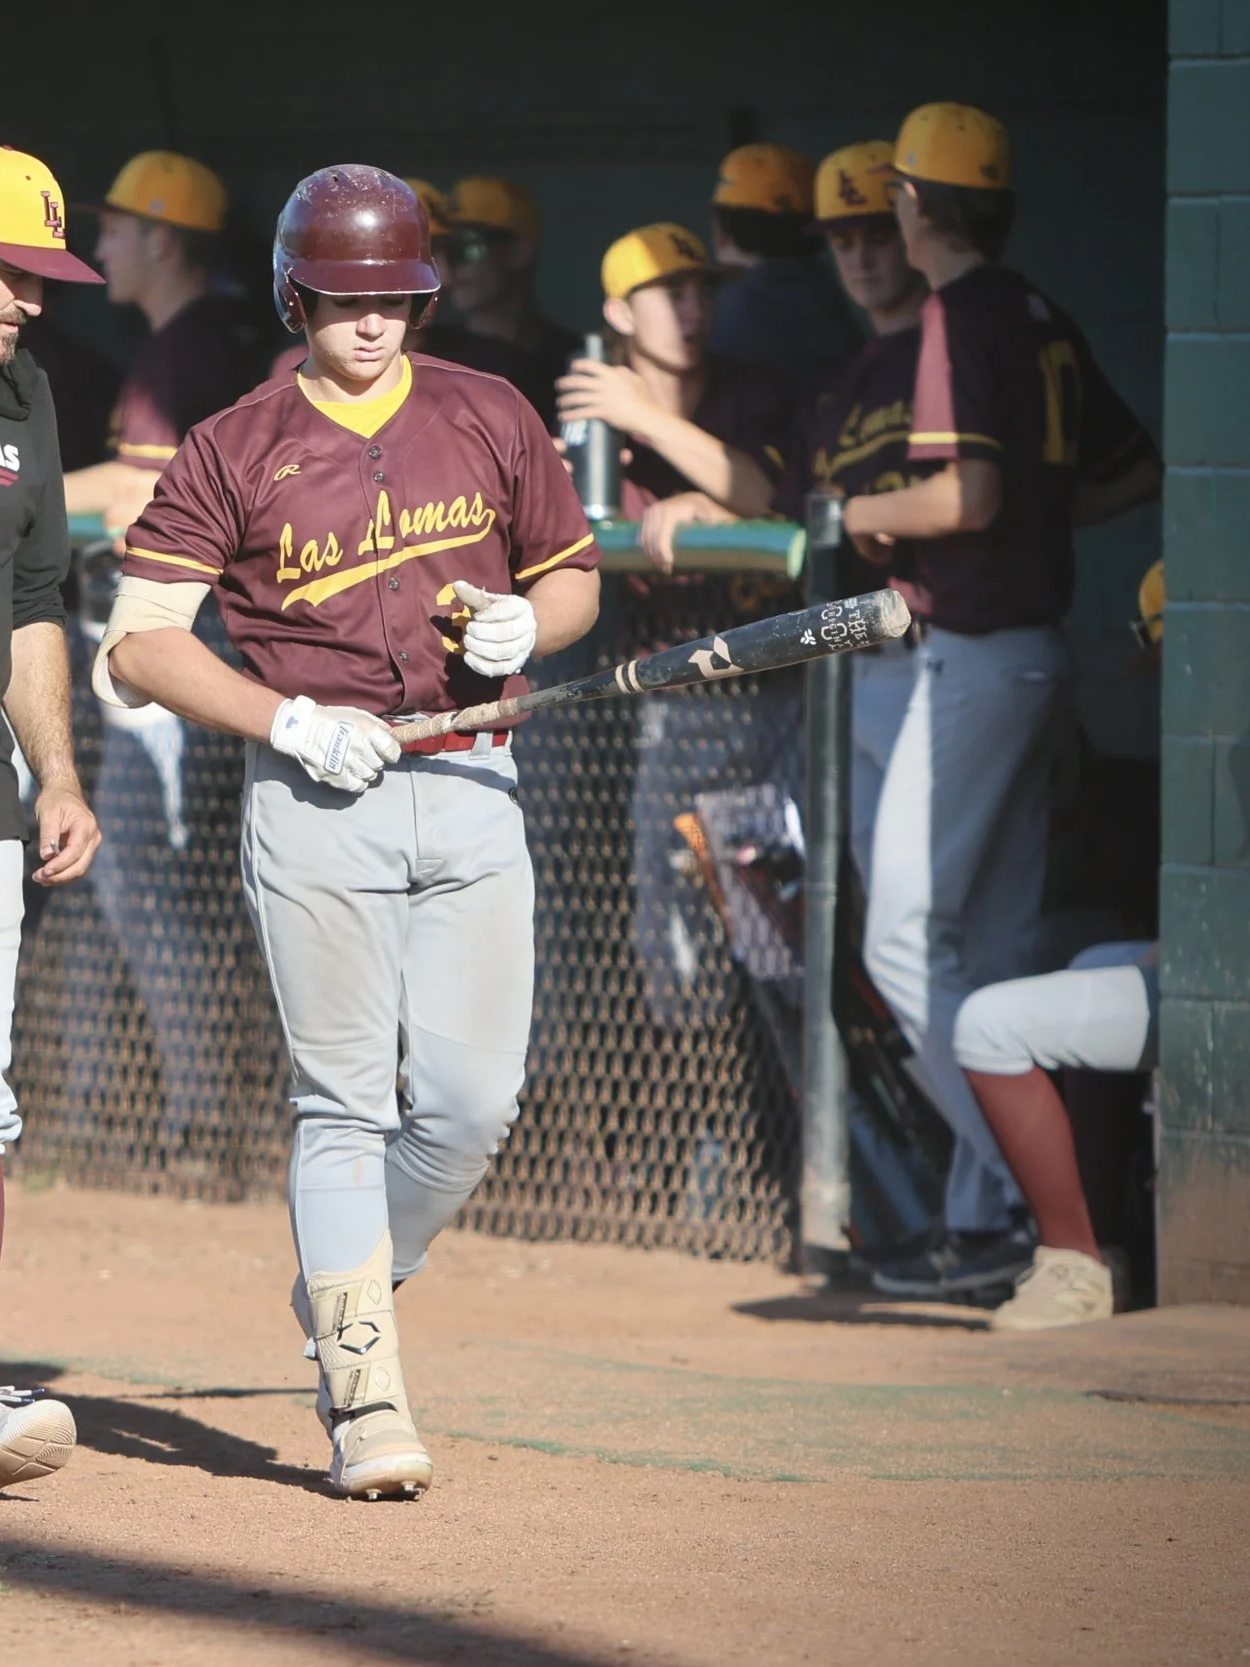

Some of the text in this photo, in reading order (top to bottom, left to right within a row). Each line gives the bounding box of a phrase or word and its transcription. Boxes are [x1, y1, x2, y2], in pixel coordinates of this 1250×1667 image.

[276, 489, 492, 584] Las Lomas
[849, 609, 868, 640] THE
